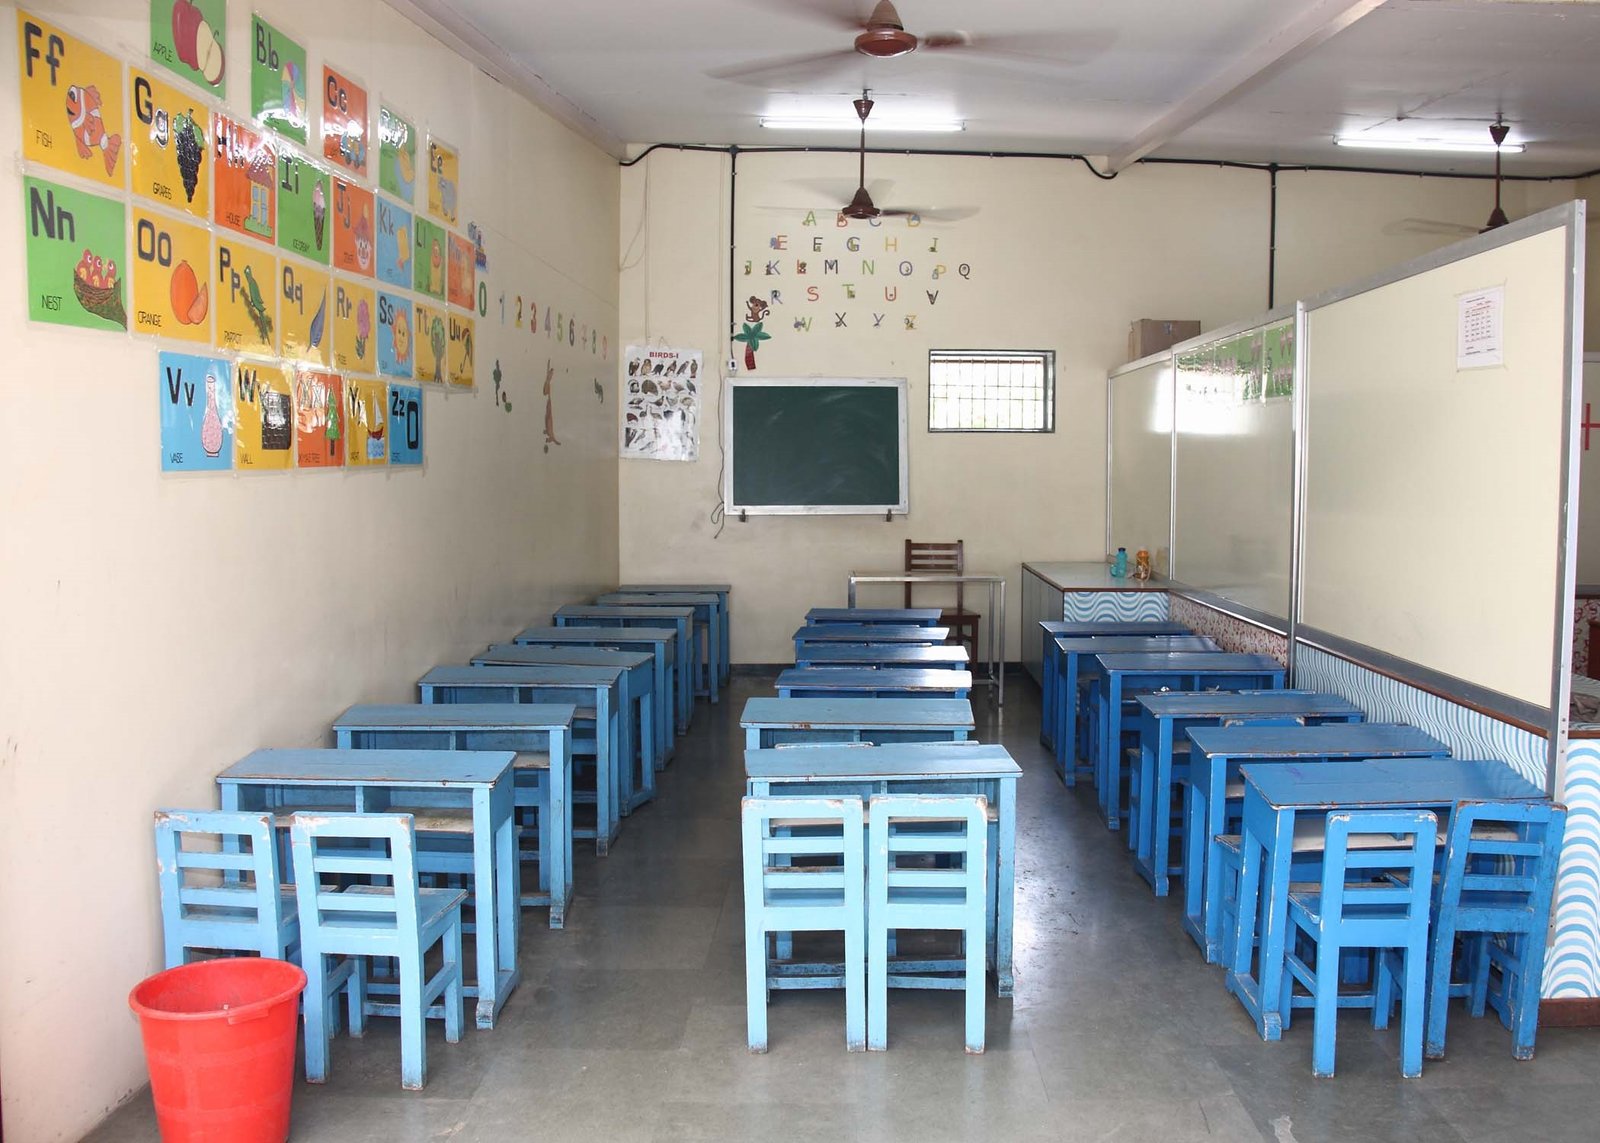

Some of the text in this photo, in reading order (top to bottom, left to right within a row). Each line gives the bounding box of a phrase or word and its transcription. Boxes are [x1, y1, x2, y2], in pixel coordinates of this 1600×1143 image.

[25, 22, 64, 86] Ff
[153, 42, 172, 63] APPLE
[256, 22, 279, 71] Bb
[135, 77, 168, 148] Gg
[30, 187, 75, 242] Nn
[337, 182, 350, 229] Jj
[380, 203, 394, 236] Kk
[804, 211, 817, 226] A
[138, 218, 172, 267] Oo
[776, 235, 788, 250] E
[813, 237, 823, 252] F
[846, 236, 860, 252] G
[885, 237, 897, 252] H
[220, 246, 240, 303] Pp
[767, 260, 780, 275] K
[824, 259, 838, 275] M
[862, 260, 874, 275] N
[899, 261, 913, 276] O
[958, 263, 970, 280] Q
[41, 295, 62, 311] NEST
[284, 266, 303, 315] Qq
[337, 286, 352, 318] Rr
[771, 284, 939, 305] R S T U V
[138, 311, 162, 327] ORANGE
[380, 296, 394, 326] Ss
[416, 307, 429, 336] Tt
[479, 281, 488, 317] 0
[499, 290, 505, 325] 1
[515, 294, 523, 330] 2
[530, 302, 537, 334] 3
[544, 306, 552, 338] 4
[557, 311, 563, 342] 5
[569, 317, 575, 347] 6
[591, 329, 597, 354] 8
[835, 312, 847, 328] X
[873, 313, 885, 327] Y
[449, 317, 461, 342] Uu
[649, 351, 679, 359] BIRDS-I
[166, 367, 195, 406] Vv
[170, 452, 184, 464] VASE
